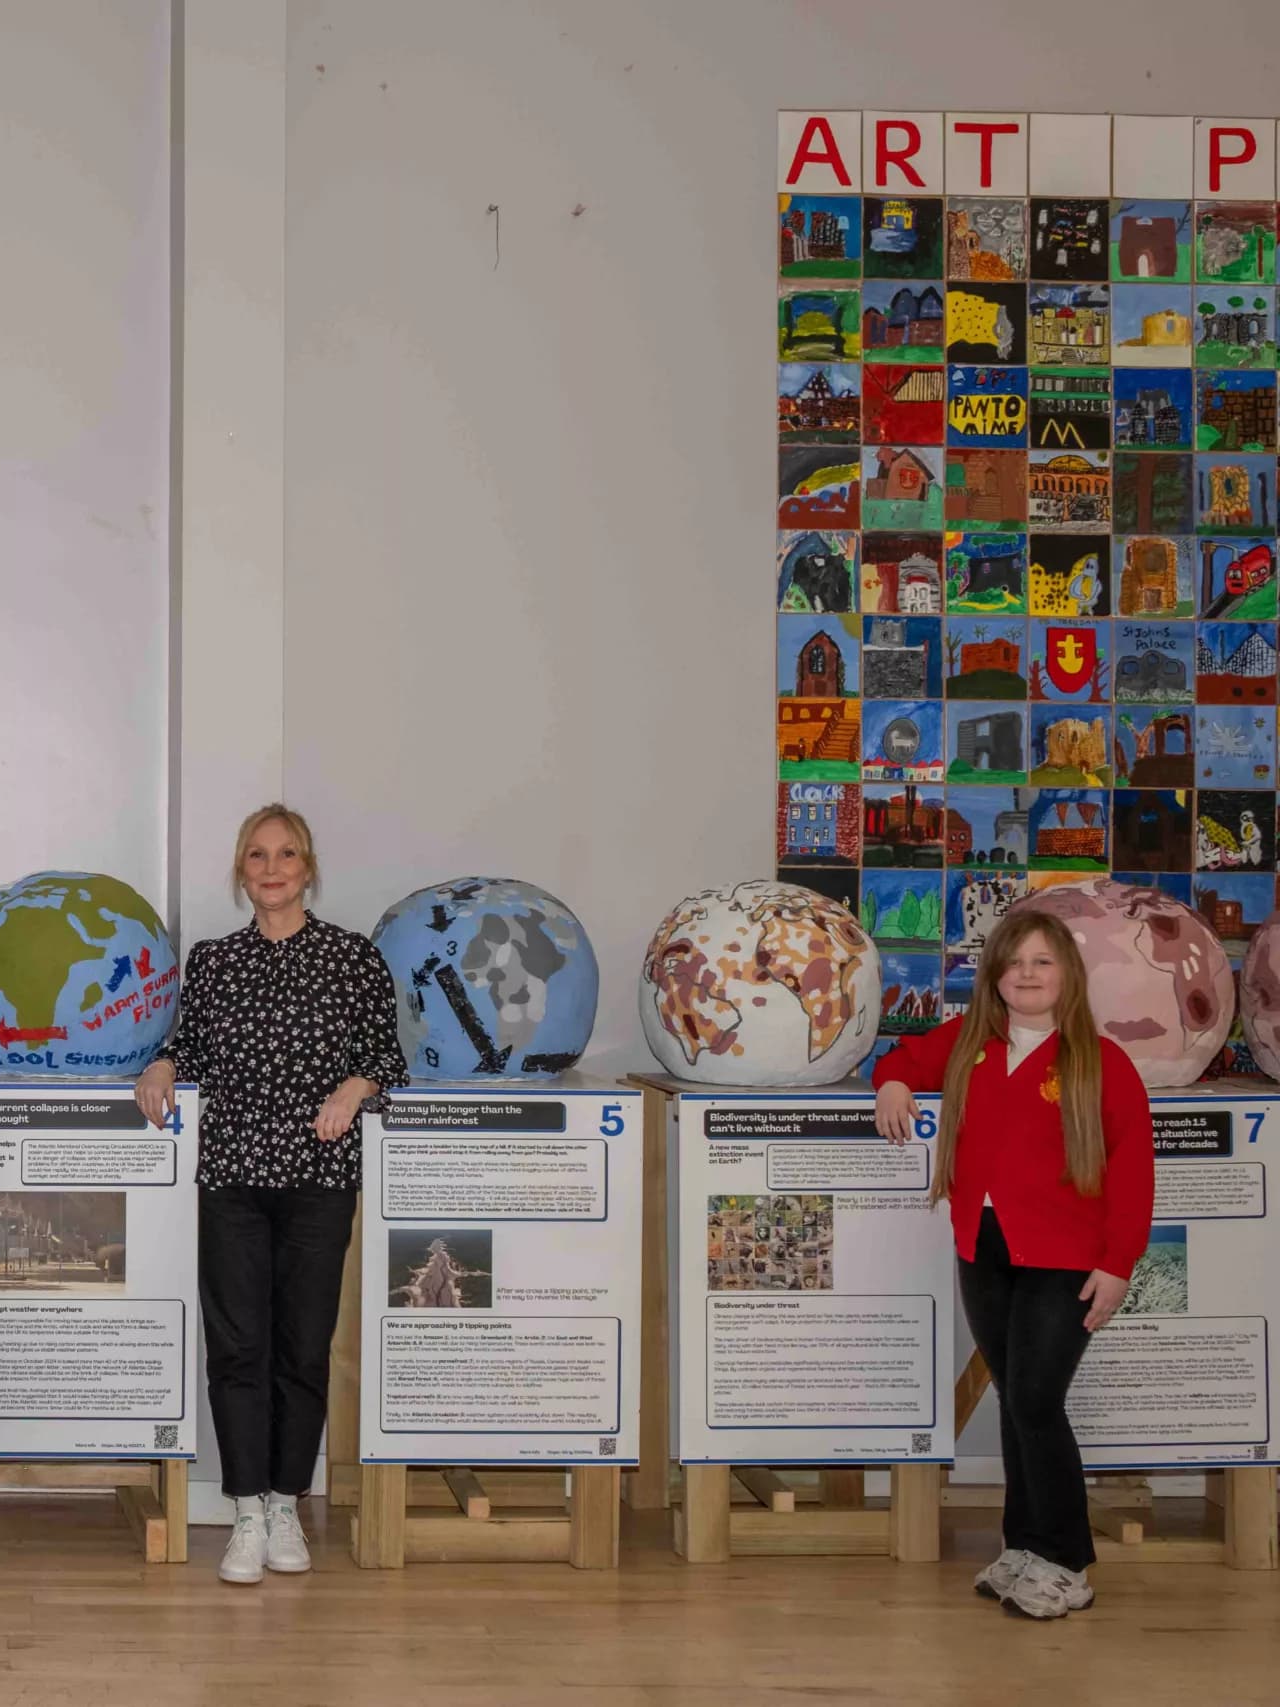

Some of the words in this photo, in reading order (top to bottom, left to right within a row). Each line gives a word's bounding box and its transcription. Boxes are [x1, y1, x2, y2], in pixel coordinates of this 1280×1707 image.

[1209, 127, 1258, 192] P
[953, 395, 1021, 419] PANTO
[1136, 638, 1177, 651] Palace
[446, 940, 458, 956] 3
[425, 1047, 439, 1067] 8
[30, 1104, 69, 1114] collapse
[71, 1104, 79, 1112] is
[81, 1104, 110, 1112] closer
[388, 1105, 406, 1113] You
[407, 1107, 429, 1115] may
[430, 1105, 447, 1113] live
[448, 1105, 478, 1115] longer
[162, 1105, 184, 1135] 4
[599, 1105, 624, 1137] 5
[710, 1113, 768, 1123] Biodiversity
[769, 1113, 777, 1121] is
[778, 1113, 805, 1121] under
[808, 1113, 839, 1121] threat
[841, 1113, 859, 1121] and
[915, 1109, 937, 1139] 6
[1164, 1118, 1192, 1127] reach
[710, 1124, 735, 1132] can't
[736, 1124, 753, 1132] live
[755, 1124, 792, 1132] without
[793, 1124, 801, 1132] it
[1245, 1113, 1265, 1144] 7
[1162, 1140, 1177, 1148] for
[1179, 1140, 1218, 1148] decades
[414, 1322, 458, 1330] approaching
[465, 1322, 489, 1330] tipping
